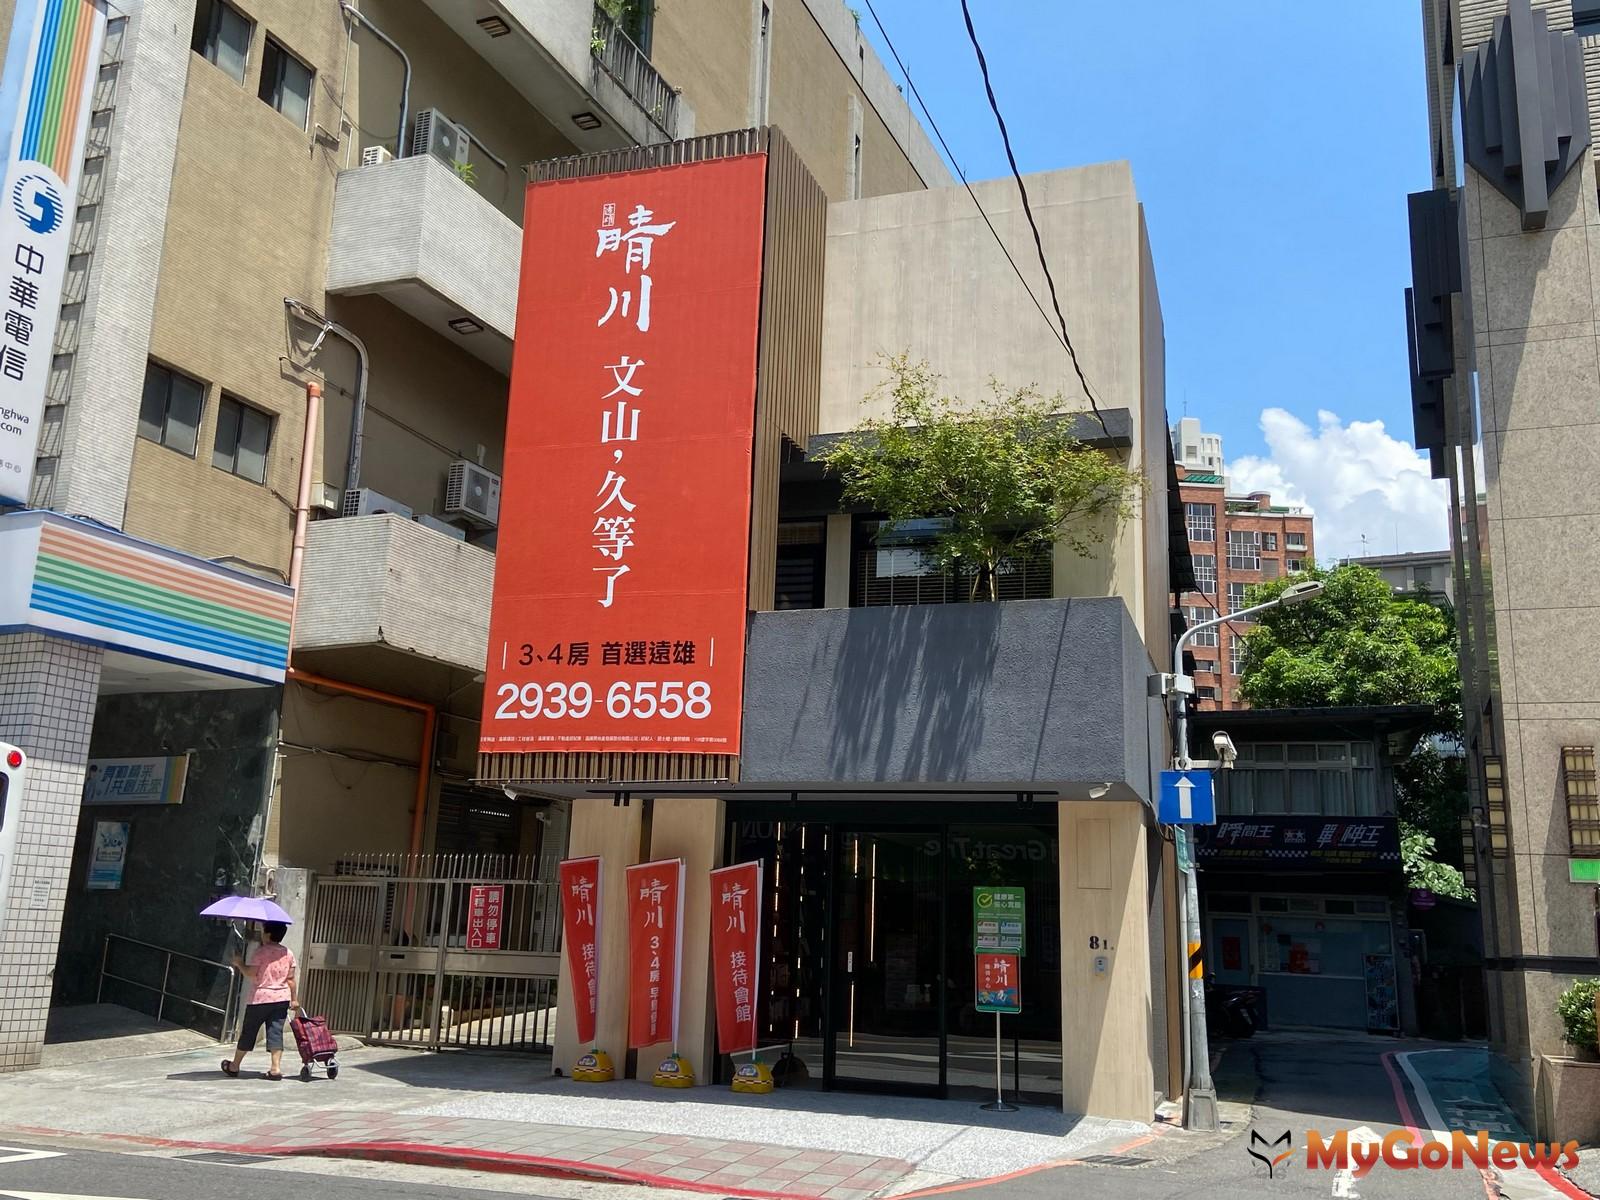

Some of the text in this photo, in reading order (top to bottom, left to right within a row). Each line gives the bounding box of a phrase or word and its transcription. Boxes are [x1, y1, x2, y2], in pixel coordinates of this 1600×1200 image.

[596, 204, 677, 332] 晴川
[0, 243, 44, 382] 中華電信
[601, 640, 696, 667] 首選遠雄
[494, 681, 712, 720] 2939-6558
[1216, 822, 1275, 845] 瞬間王
[471, 888, 486, 948] 工程車出入口
[486, 890, 500, 945] 請勿停車
[572, 876, 594, 926] 晴川
[639, 879, 669, 929] 晴川
[722, 882, 750, 933] 晴川
[730, 951, 751, 1022] 接待會館
